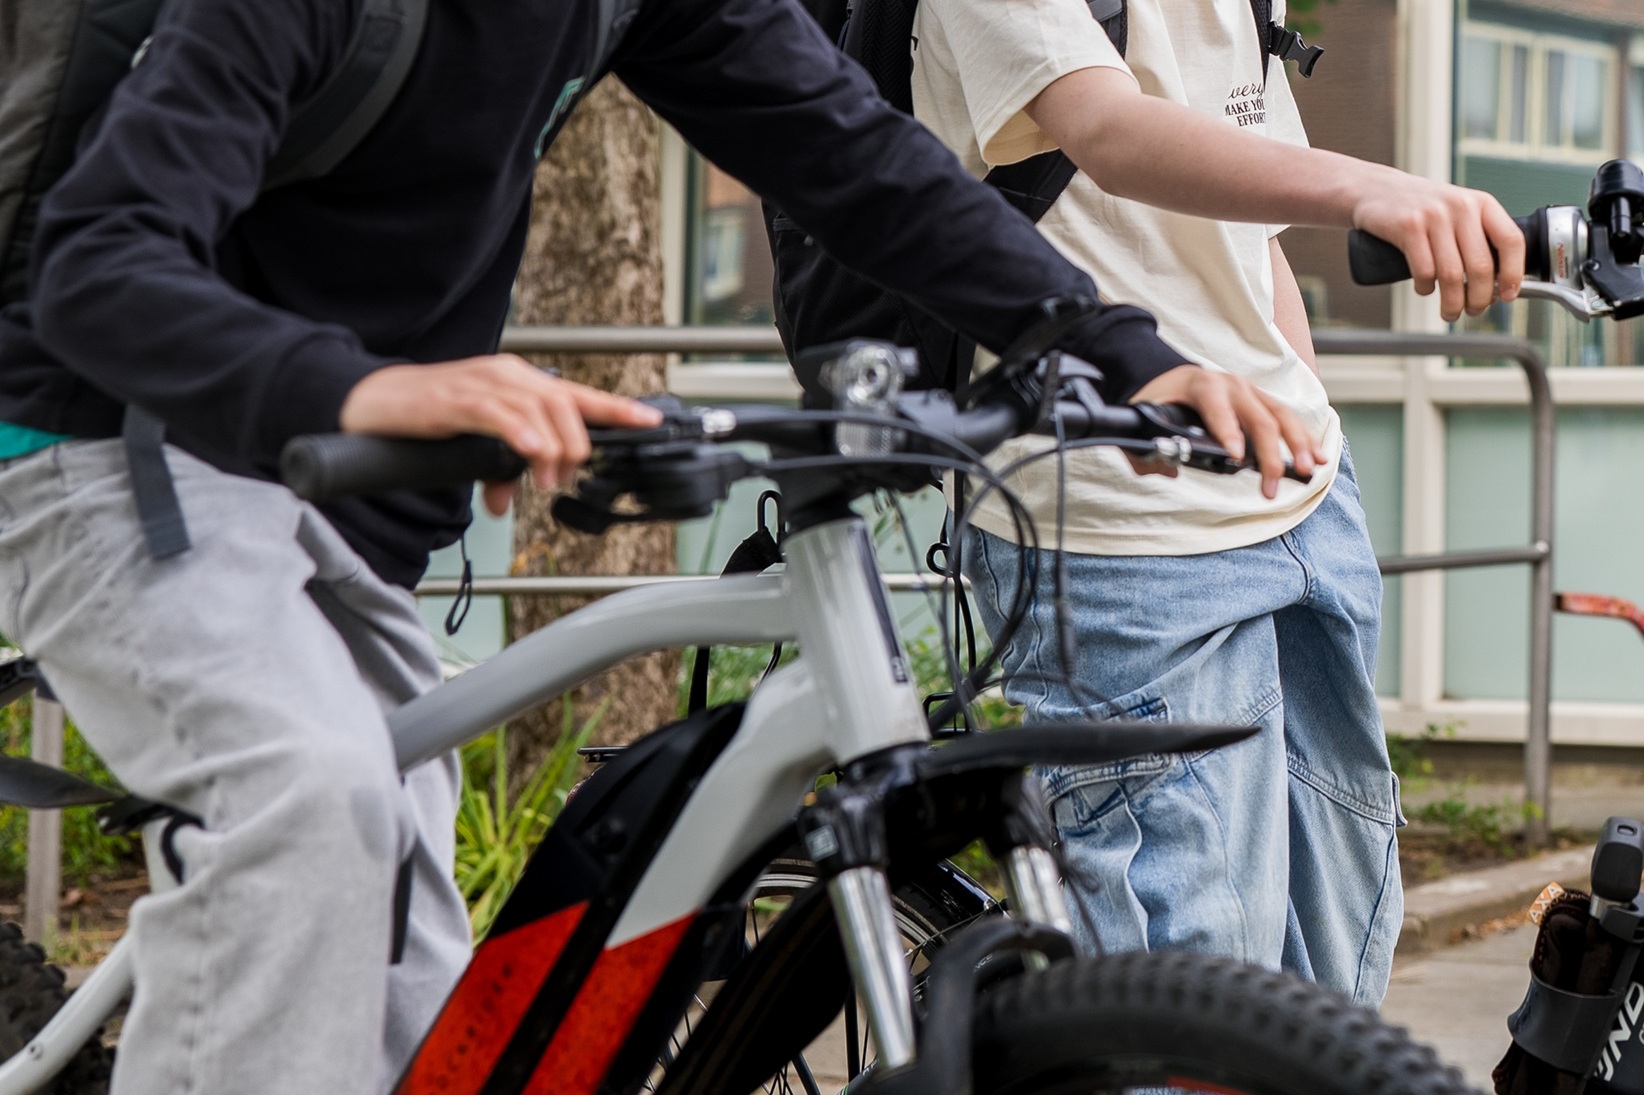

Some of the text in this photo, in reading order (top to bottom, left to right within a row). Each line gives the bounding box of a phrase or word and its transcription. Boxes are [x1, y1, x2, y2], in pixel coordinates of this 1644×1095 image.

[1225, 101, 1251, 116] MAKE
[1237, 112, 1266, 127] EFFOR
[1529, 883, 1566, 924] AXA
